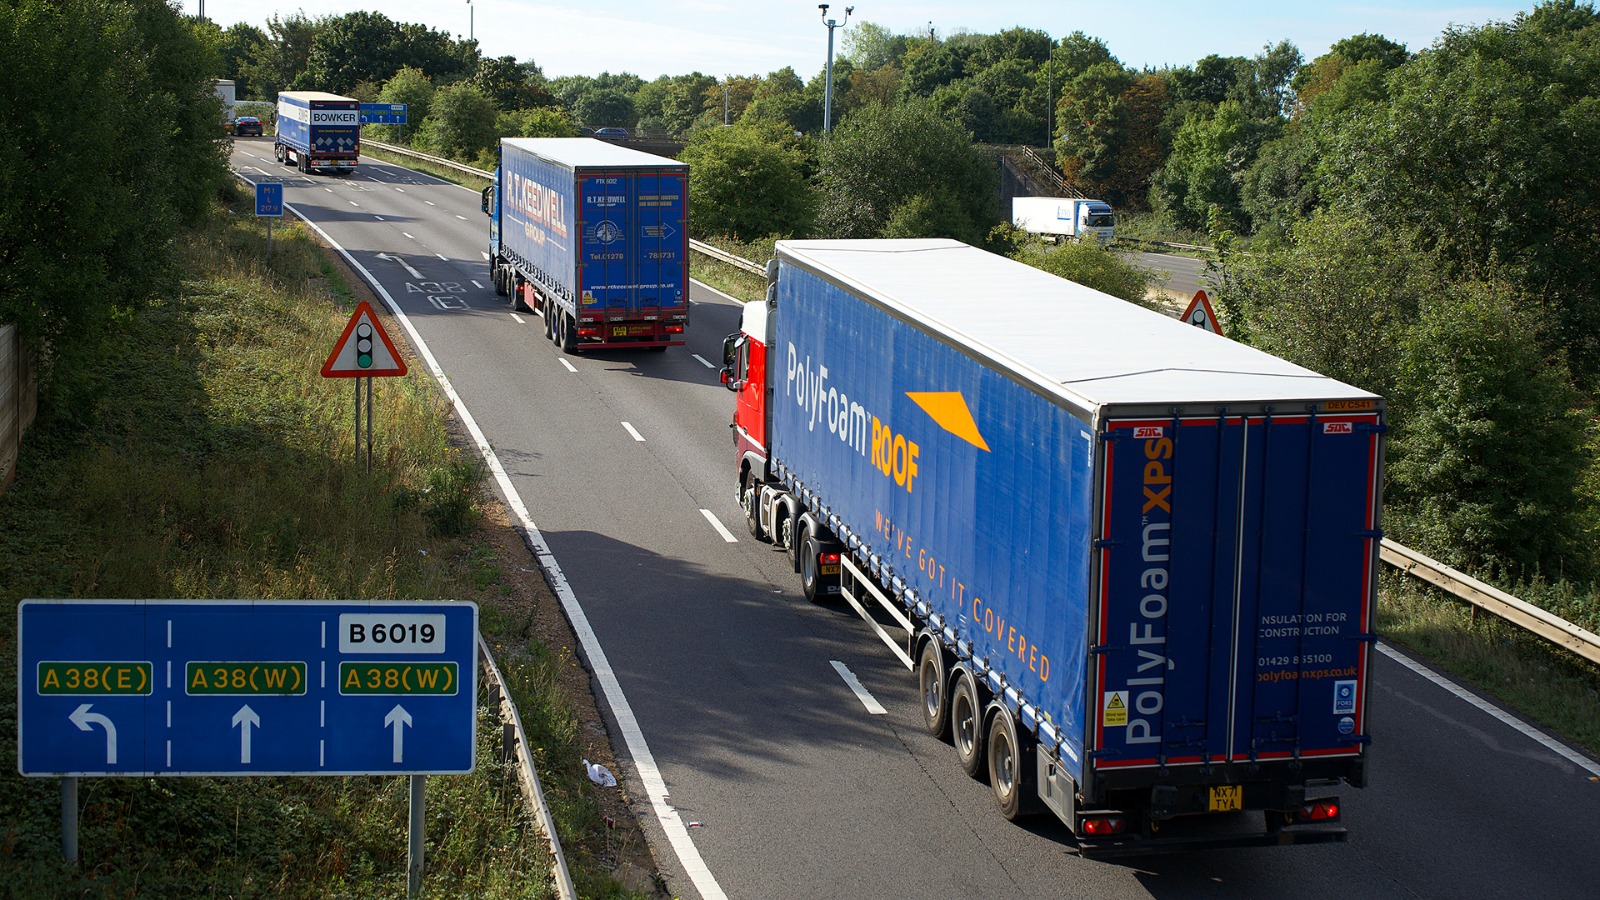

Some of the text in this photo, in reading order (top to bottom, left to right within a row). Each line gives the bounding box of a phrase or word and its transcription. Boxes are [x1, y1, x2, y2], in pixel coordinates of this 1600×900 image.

[313, 113, 356, 122] BOWKER
[524, 221, 546, 246] GROUP
[405, 281, 468, 293] A38
[1328, 400, 1370, 409] DEV C541
[1134, 427, 1162, 438] SDC
[1324, 423, 1351, 432] SDC
[871, 415, 920, 493] ROOF
[1142, 437, 1173, 514] XPS
[876, 509, 1050, 683] WE'VE GOT IT COVERED
[1261, 612, 1347, 625] NSULATON FOR
[1258, 655, 1289, 667] 01429
[1213, 787, 1238, 798] NX71
[1215, 799, 1236, 810] TYA
